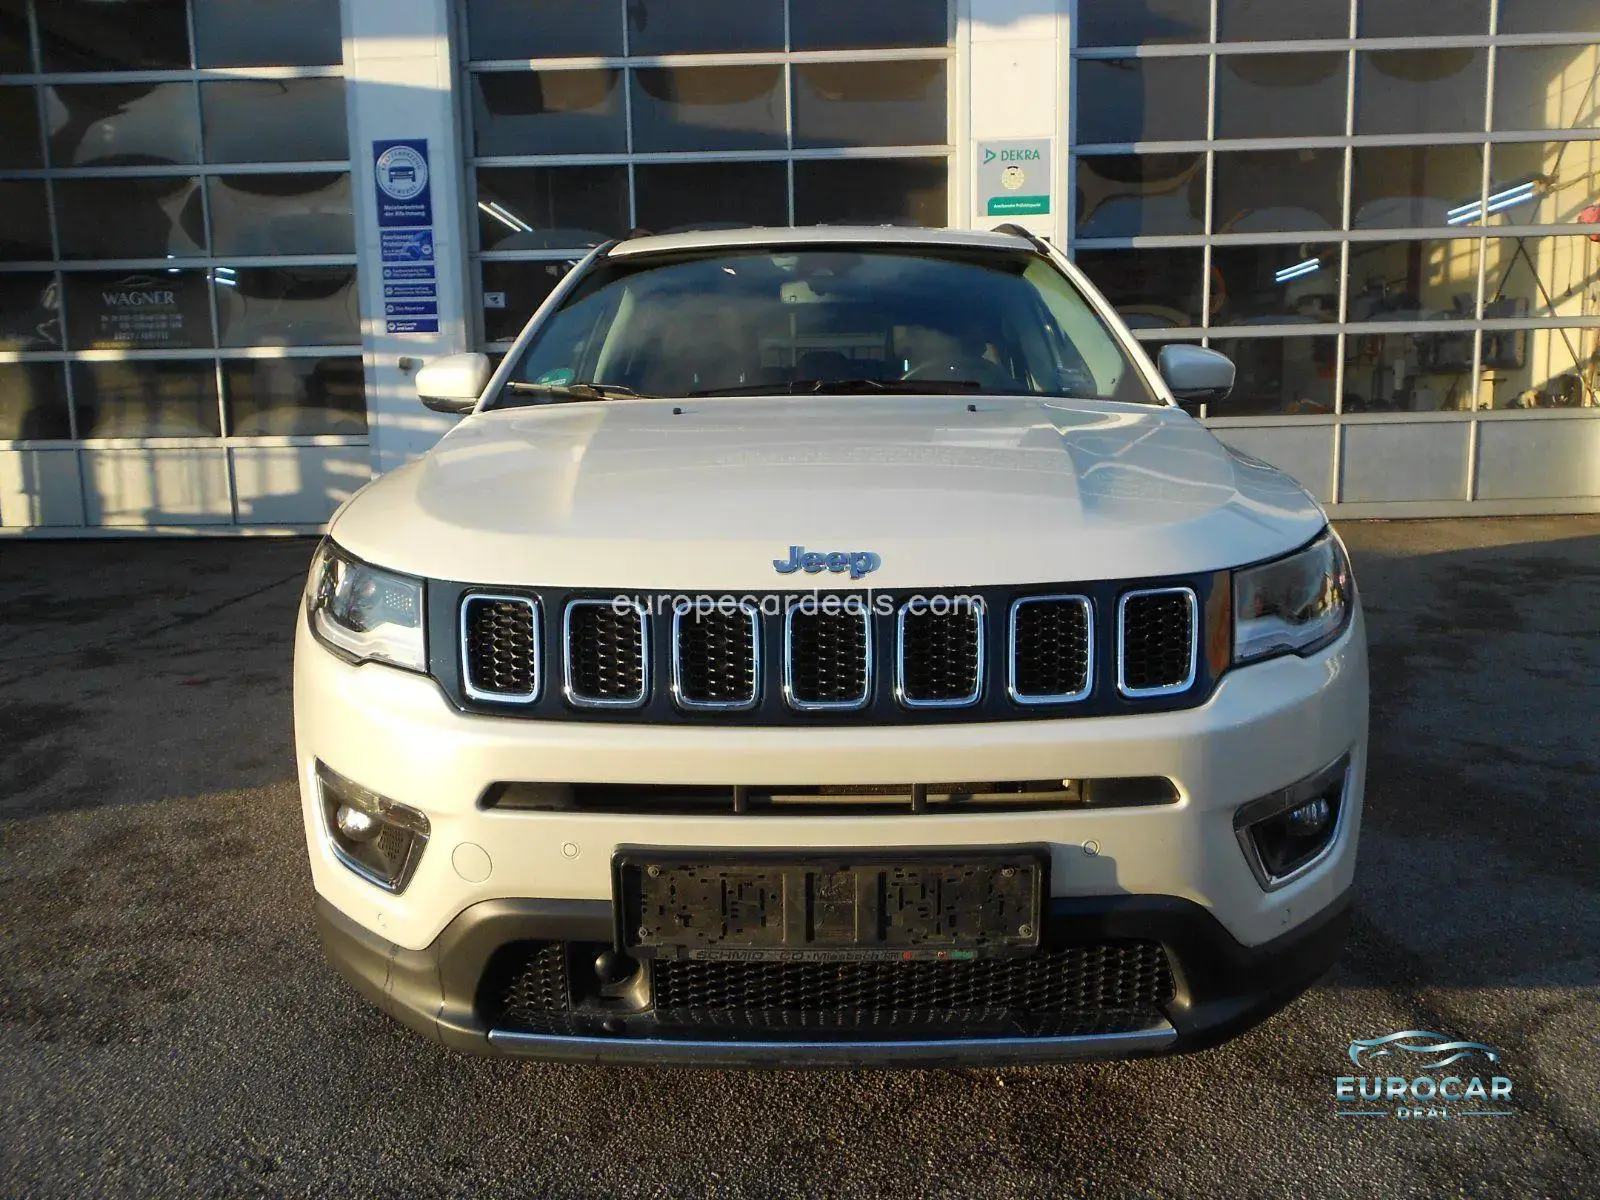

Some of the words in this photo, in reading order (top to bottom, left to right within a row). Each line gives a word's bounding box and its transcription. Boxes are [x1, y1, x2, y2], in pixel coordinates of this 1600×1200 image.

[1000, 149, 1041, 161] DEKRA
[101, 291, 177, 306] WAGNER
[773, 545, 881, 580] Jeep
